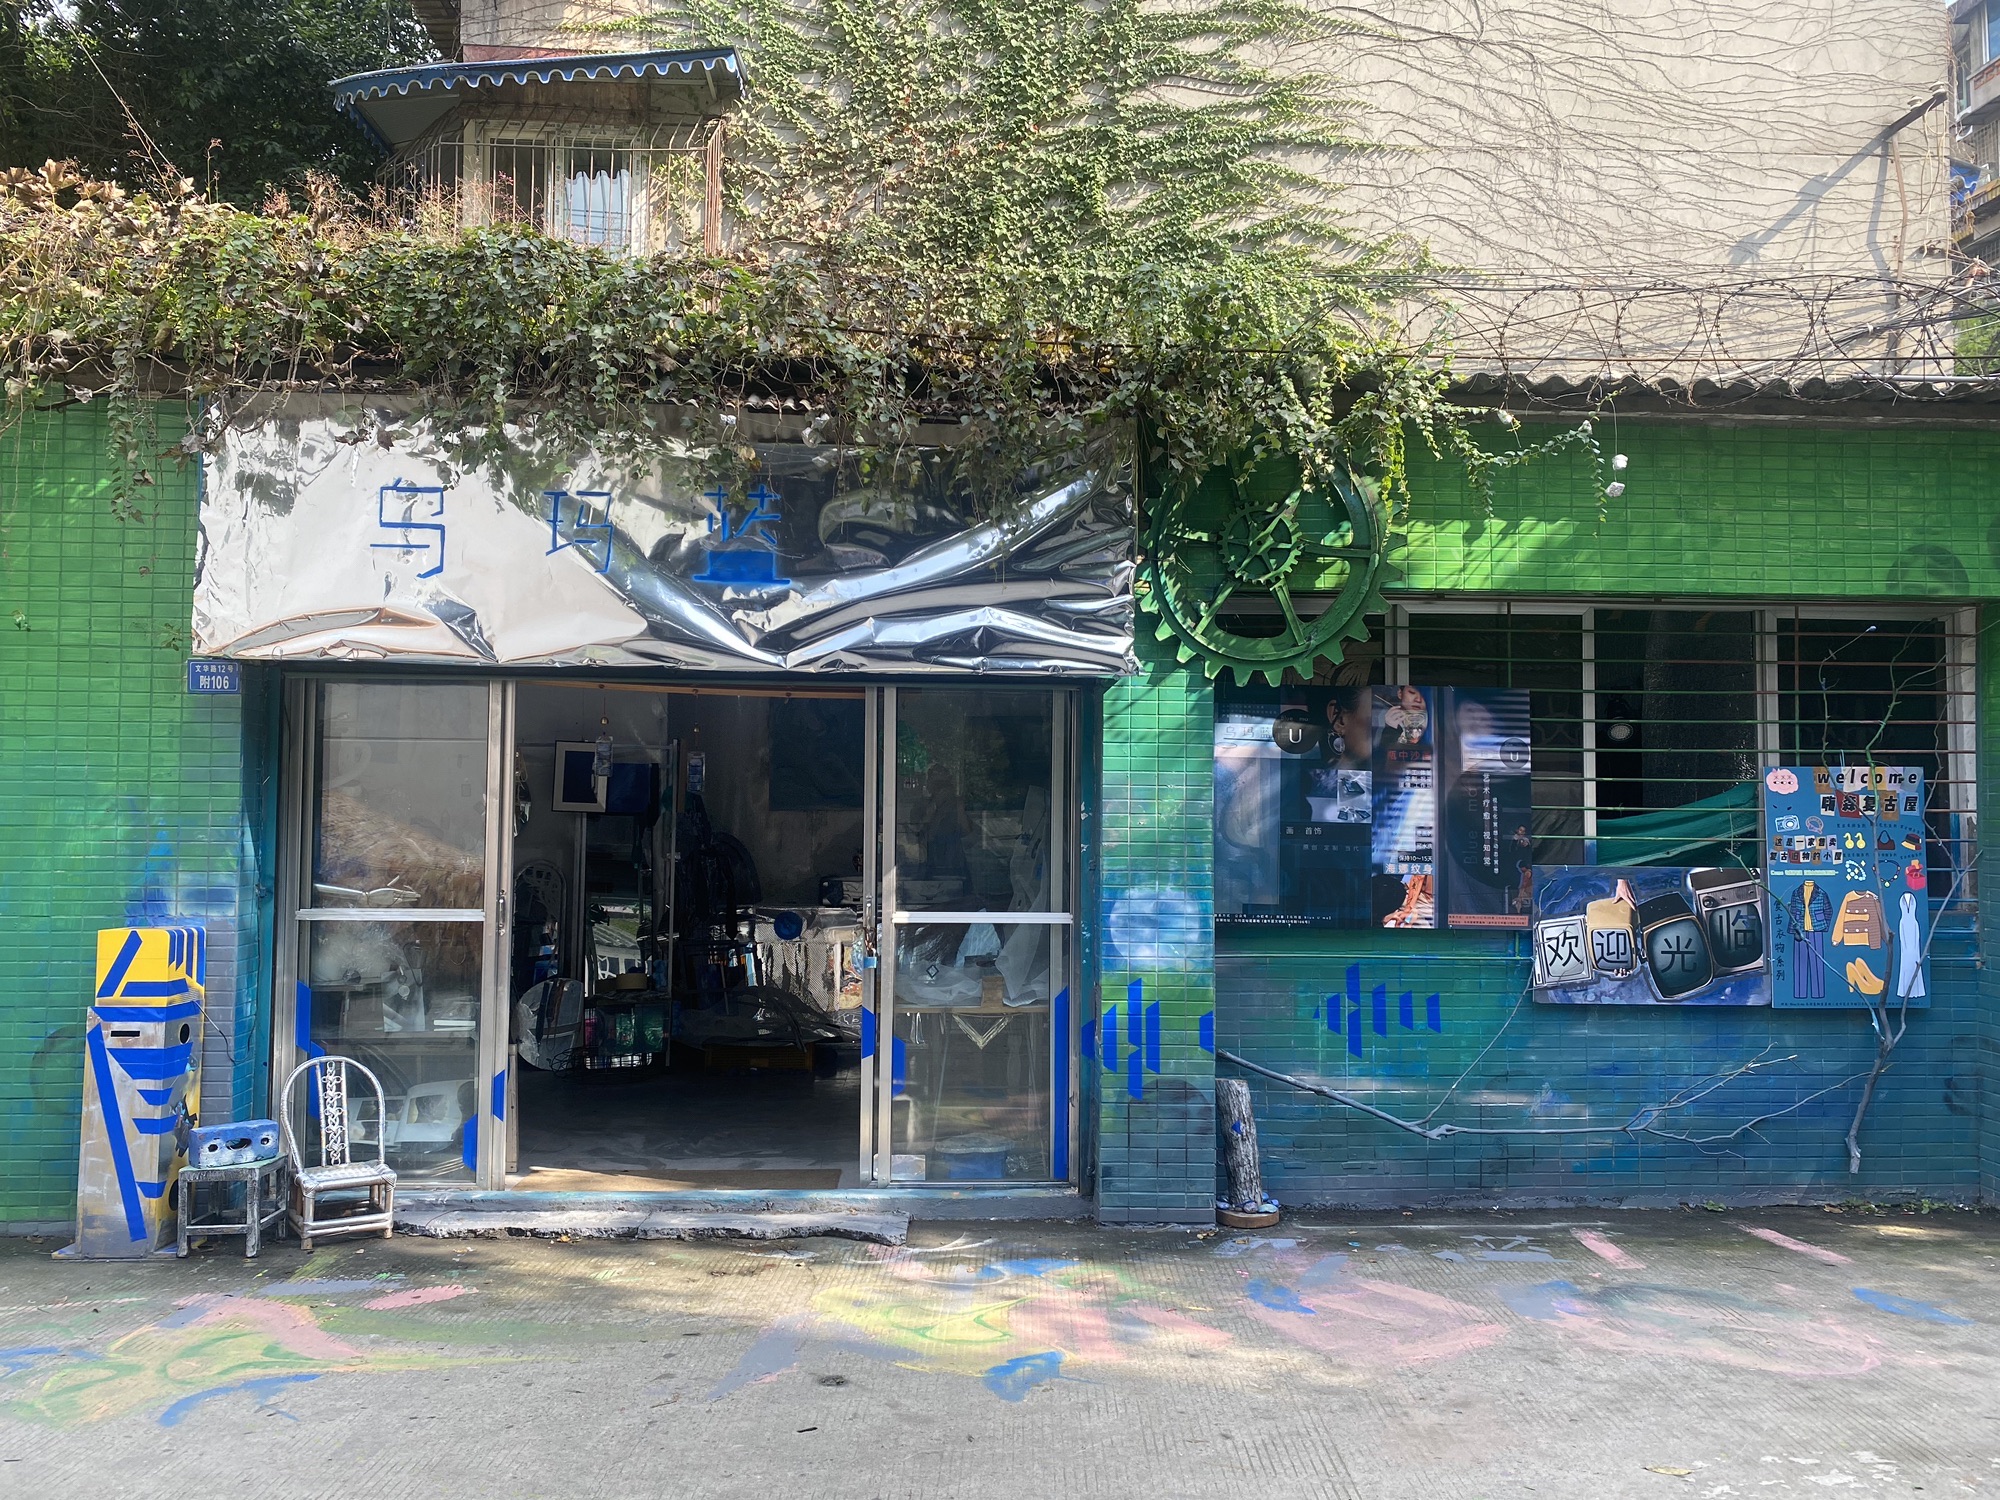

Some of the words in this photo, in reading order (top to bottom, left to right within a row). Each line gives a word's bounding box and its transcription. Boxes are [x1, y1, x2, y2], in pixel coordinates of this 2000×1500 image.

[195, 664, 234, 673] 文华路12号
[199, 675, 230, 690] 附106
[1288, 728, 1302, 744] U
[1510, 752, 1519, 762] U
[1817, 768, 1917, 784] welcome
[1774, 837, 1837, 847] 这是一家售卖
[1770, 851, 1842, 861] 复古旧物的小屋
[1385, 863, 1433, 875] 海娜纹身
[1546, 908, 1757, 975] 欢迎光临
[1773, 899, 1786, 982] 复古衣物系列
